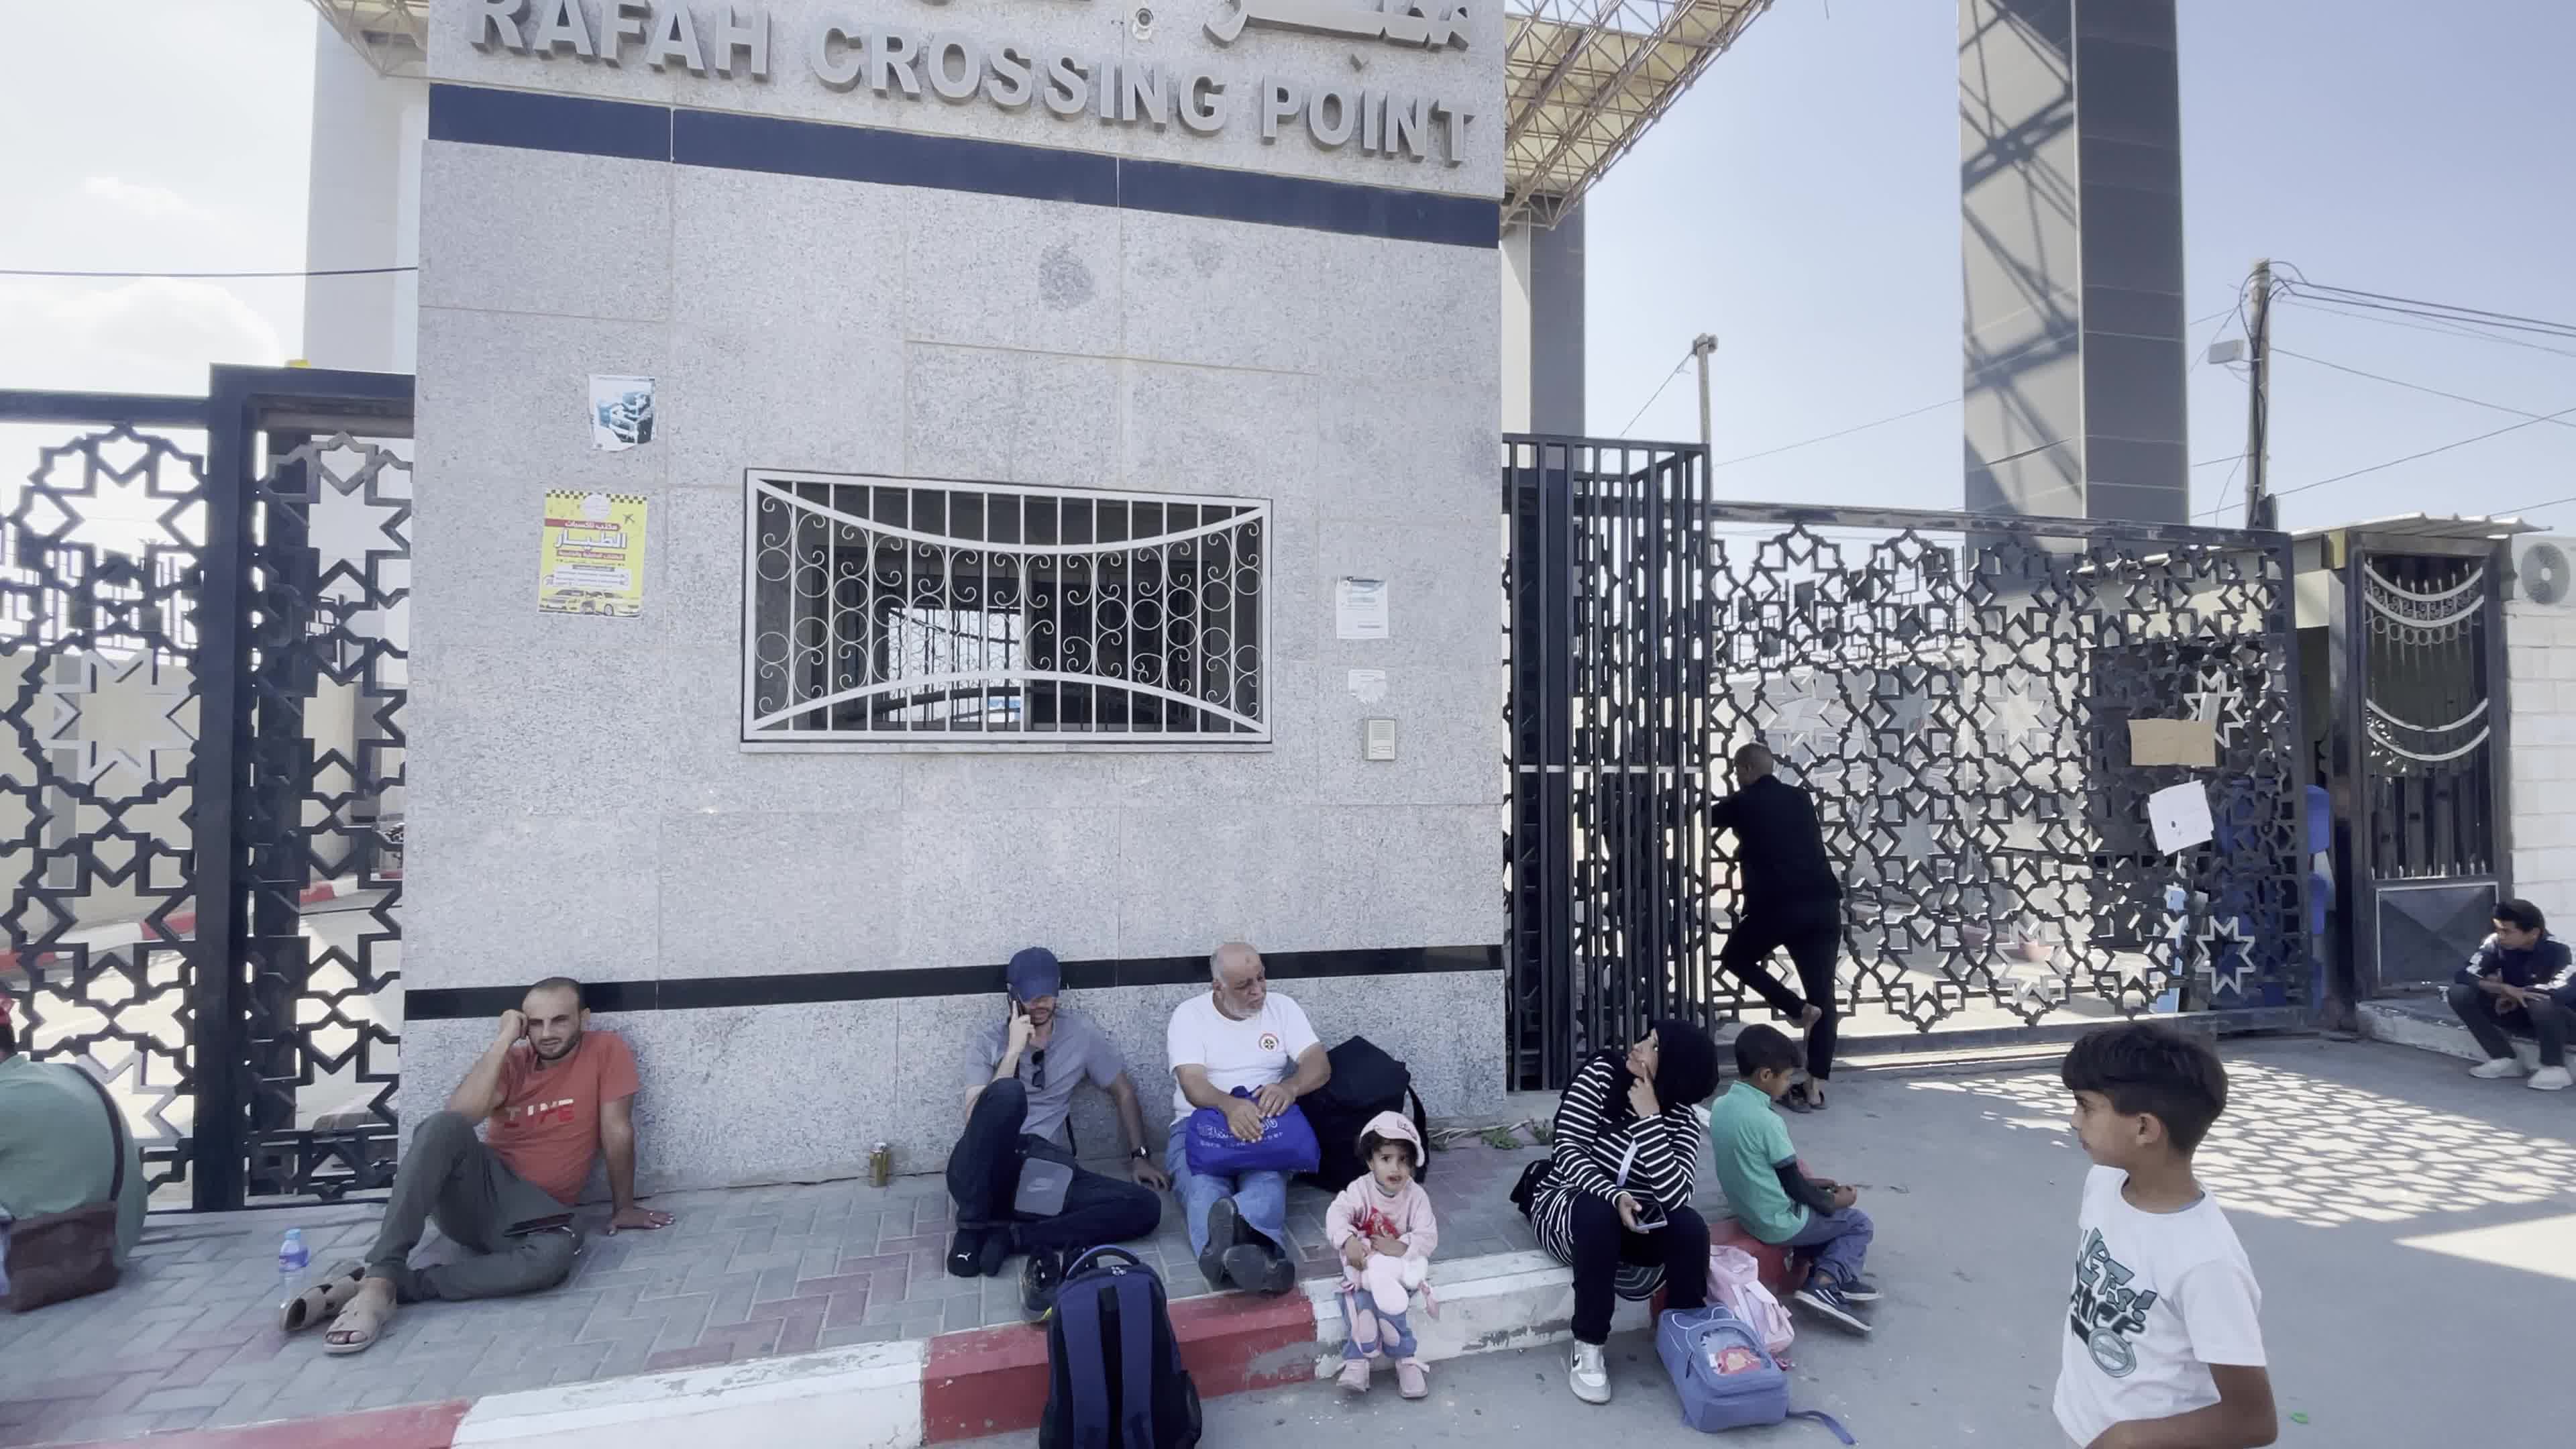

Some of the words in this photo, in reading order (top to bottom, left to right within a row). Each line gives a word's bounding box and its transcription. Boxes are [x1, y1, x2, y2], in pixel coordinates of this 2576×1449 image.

[470, 0, 769, 82] RAFAH
[812, 26, 1228, 134] CROSSING
[1261, 74, 1475, 167] POINT
